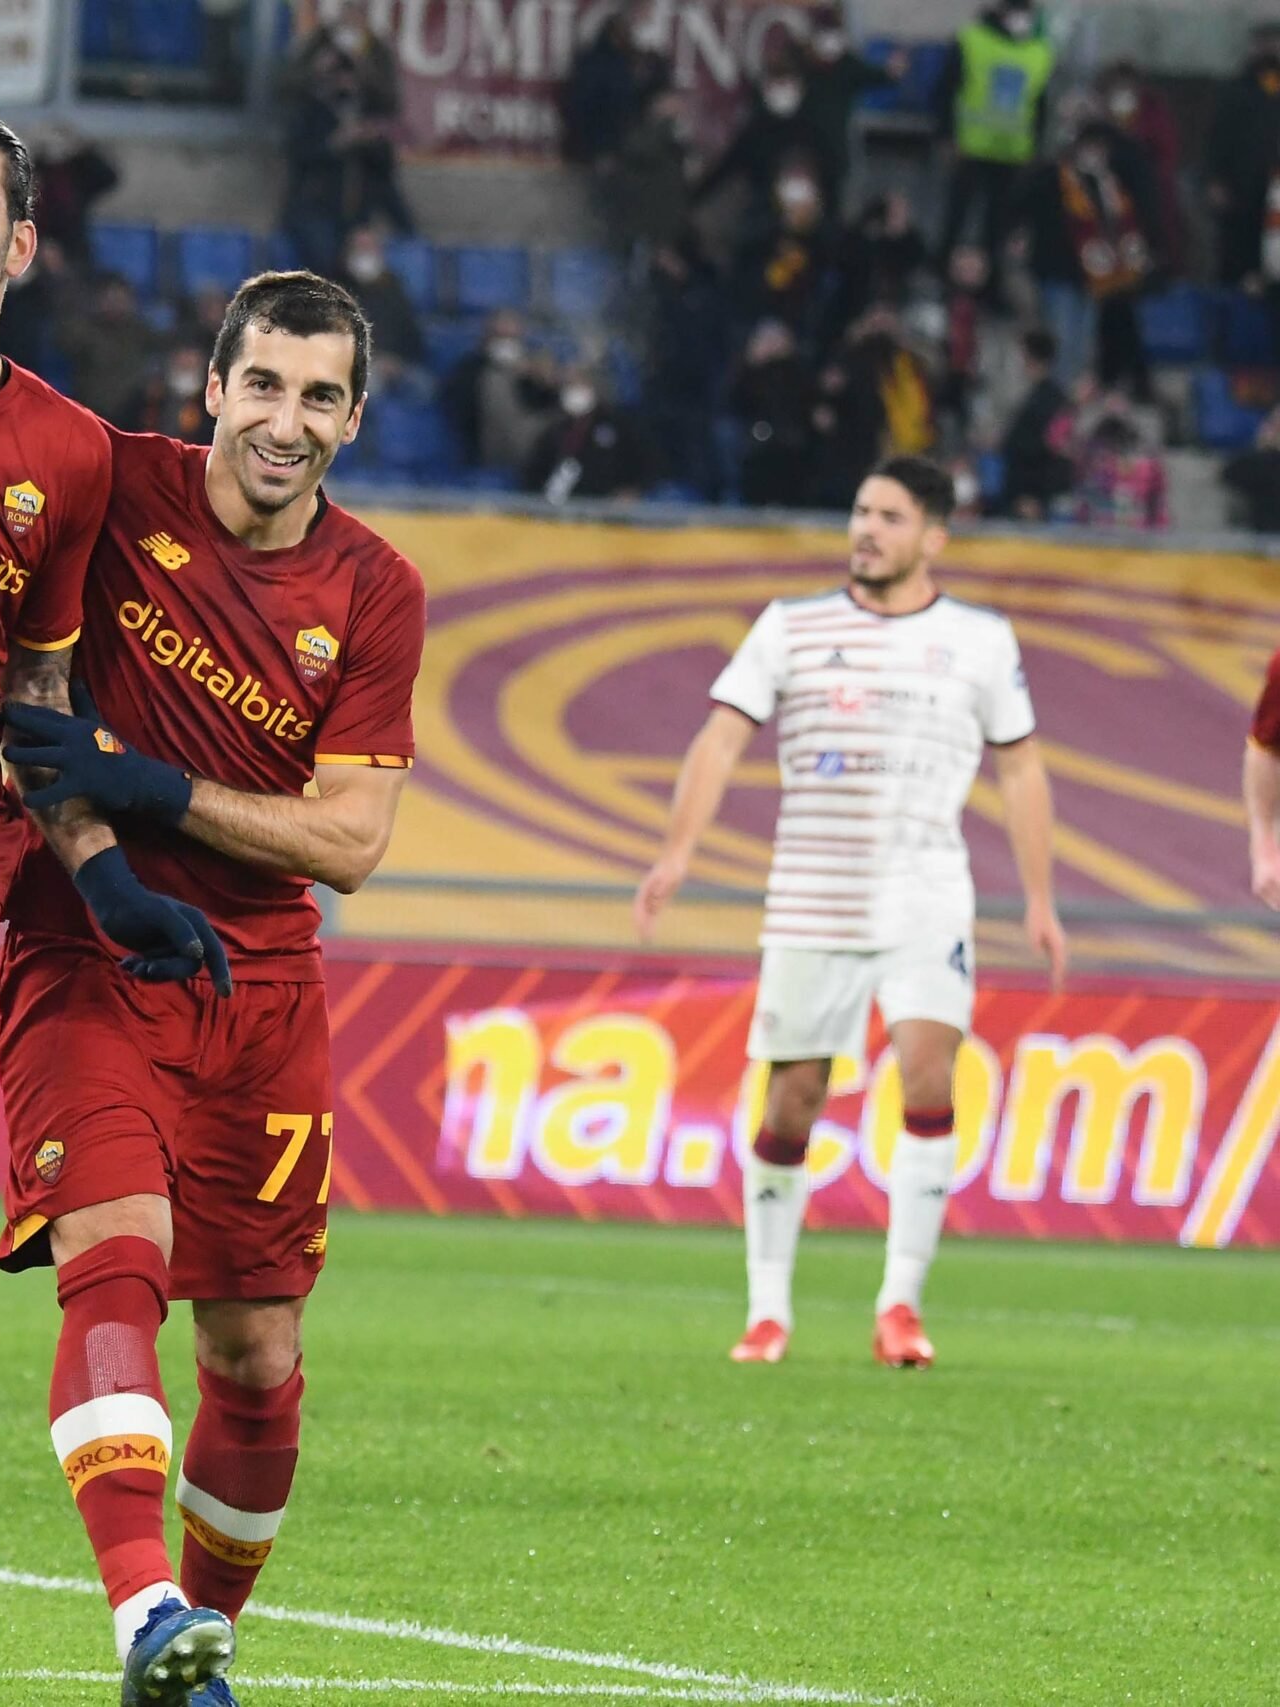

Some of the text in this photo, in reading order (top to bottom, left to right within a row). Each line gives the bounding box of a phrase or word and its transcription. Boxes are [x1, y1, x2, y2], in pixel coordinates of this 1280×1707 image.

[6, 511, 34, 527] ROMA
[118, 600, 313, 741] digitalbits
[297, 654, 328, 672] ROMA
